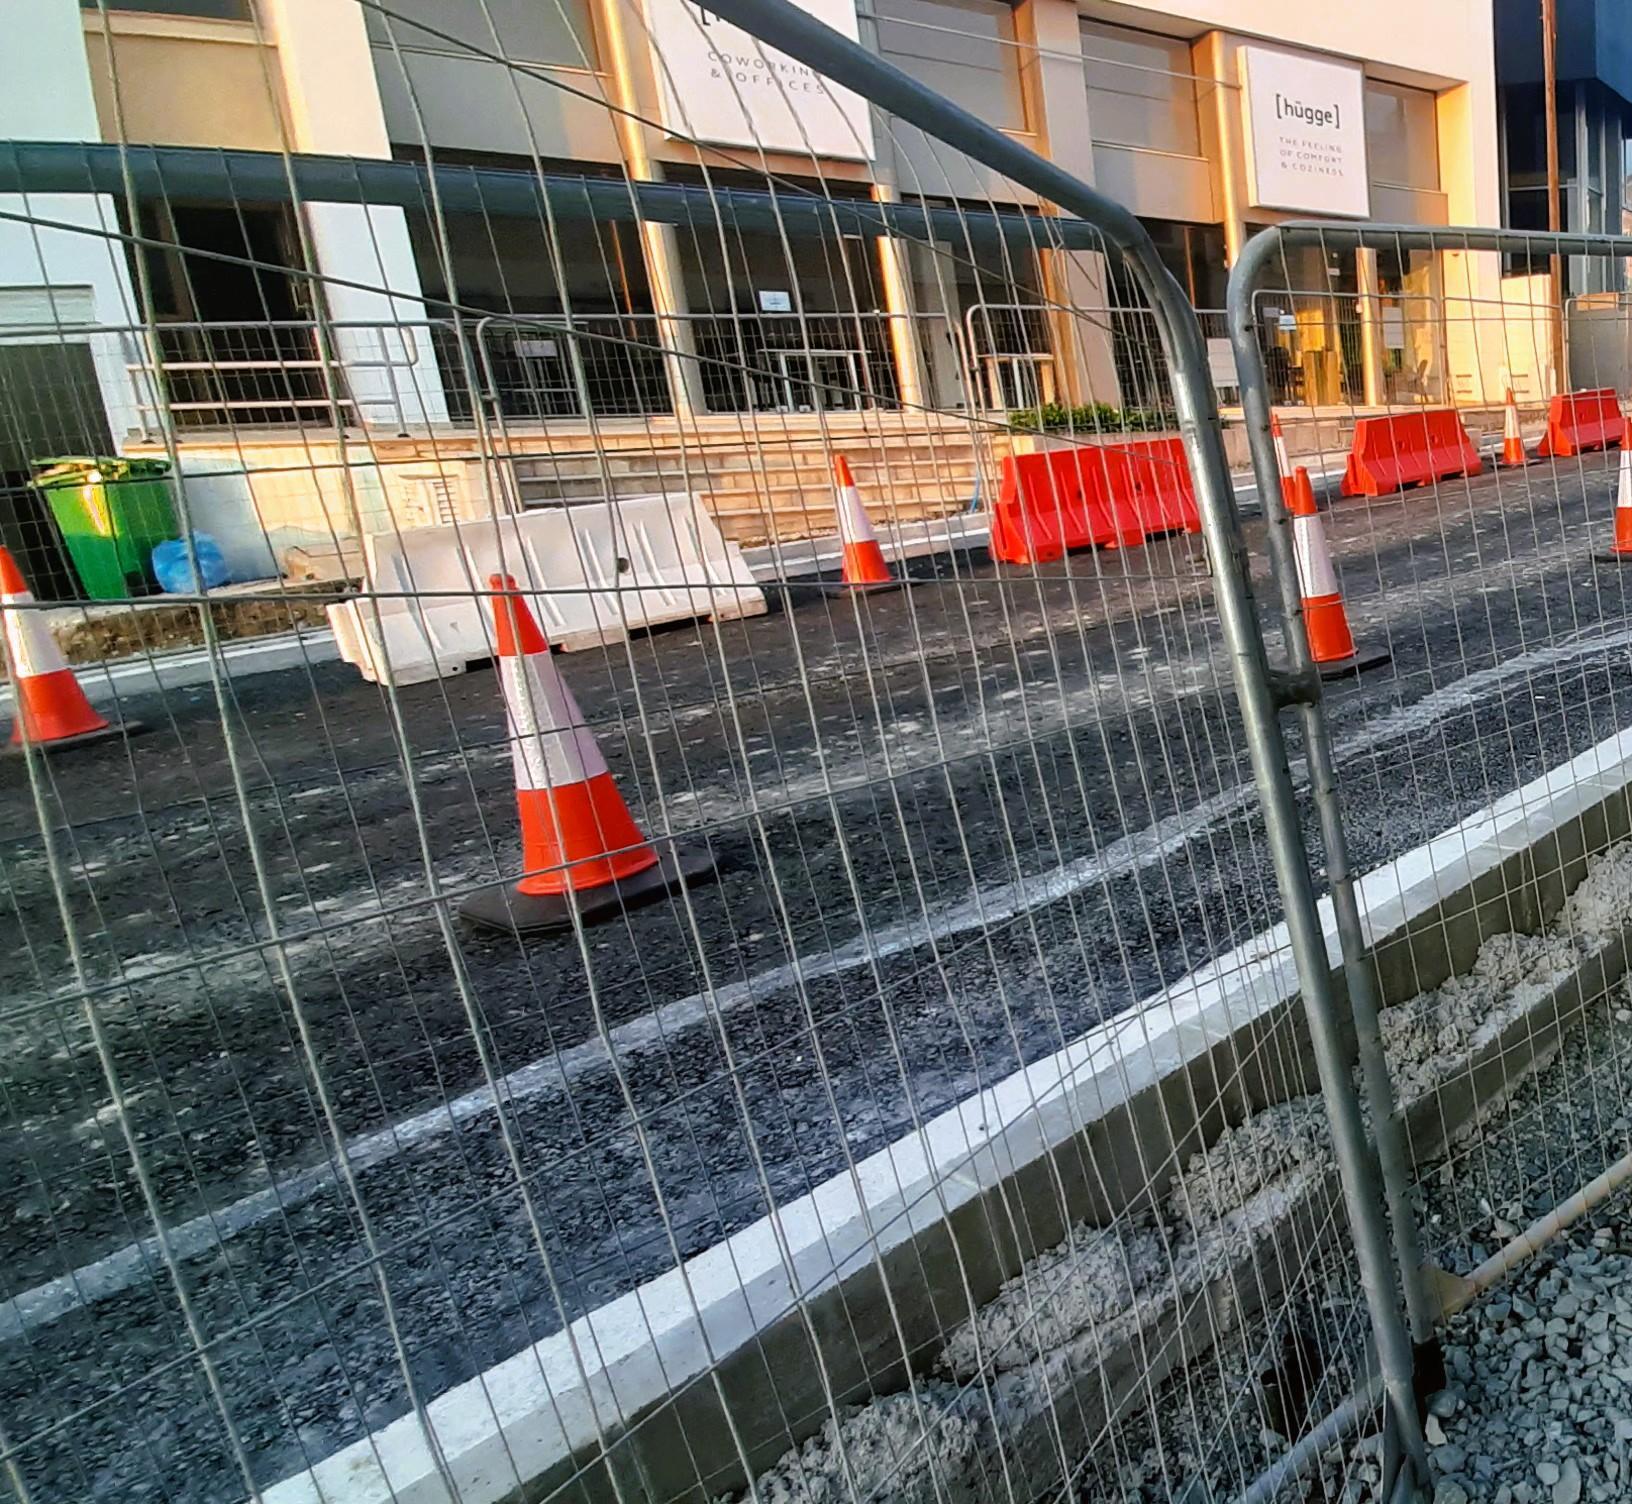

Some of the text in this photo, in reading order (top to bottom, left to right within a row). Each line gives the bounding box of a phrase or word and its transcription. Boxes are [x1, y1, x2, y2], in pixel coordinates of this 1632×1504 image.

[707, 51, 820, 80] COWORKIN
[711, 68, 720, 78] &
[1280, 136, 1342, 154] THE FEELING
[1280, 149, 1342, 163] OF COMFORT
[1281, 161, 1343, 177] & COZINESS
